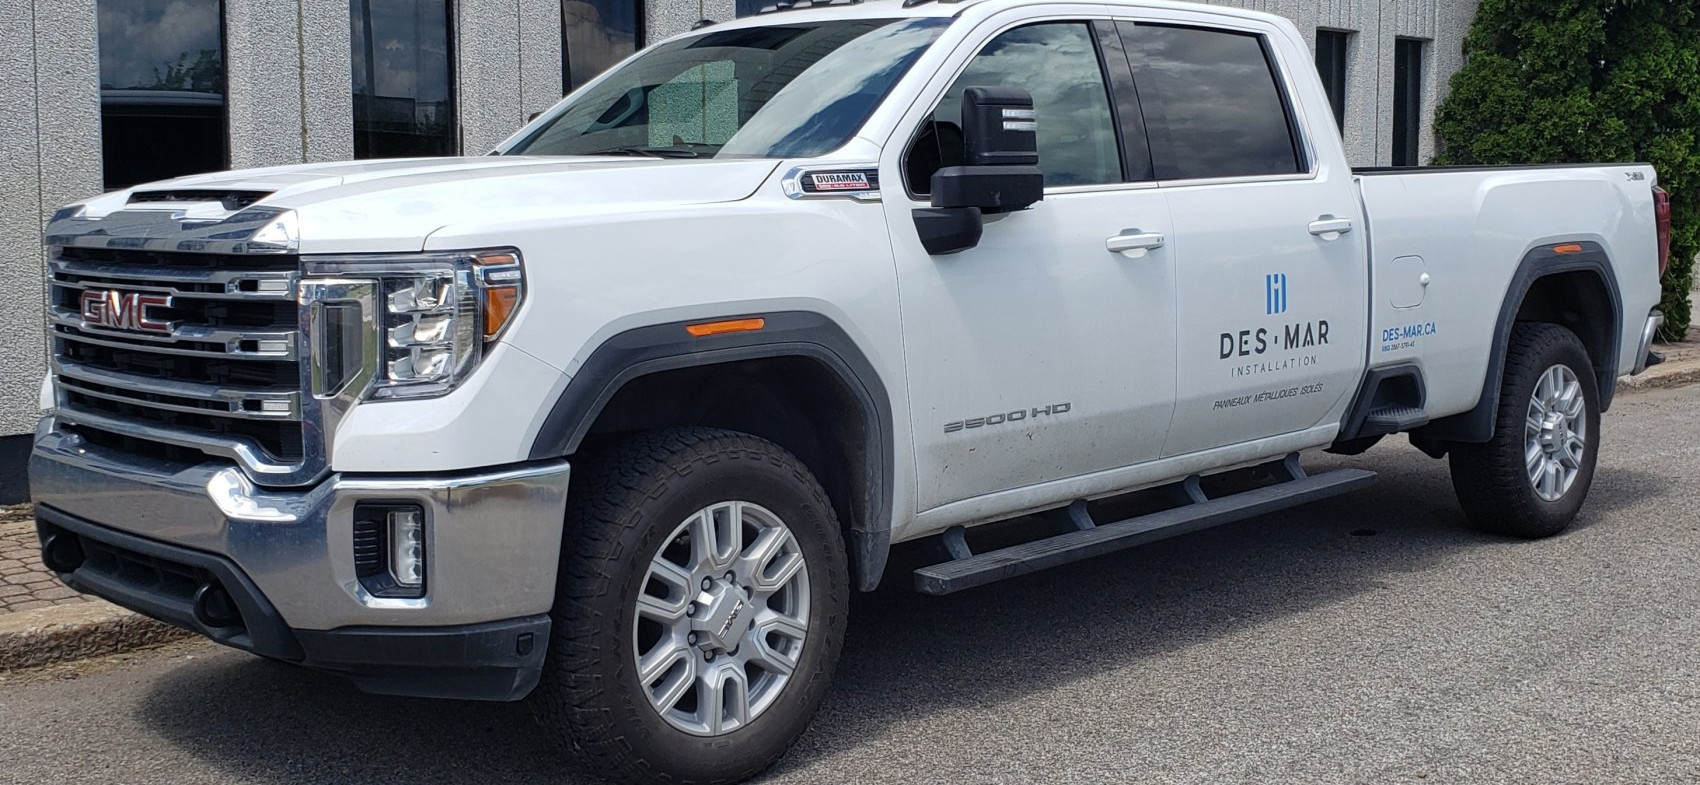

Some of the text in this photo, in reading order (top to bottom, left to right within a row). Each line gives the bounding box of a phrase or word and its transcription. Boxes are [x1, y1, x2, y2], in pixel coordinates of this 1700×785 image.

[815, 173, 864, 183] DURAMAX
[81, 289, 174, 332] GMC
[1382, 322, 1437, 342] DES-MAR.CA
[1231, 355, 1317, 378] INSTALLATION
[1213, 382, 1324, 410] PANNEAUX MÉTALLIQUES ISOLÉS
[1031, 402, 1071, 417] HD
